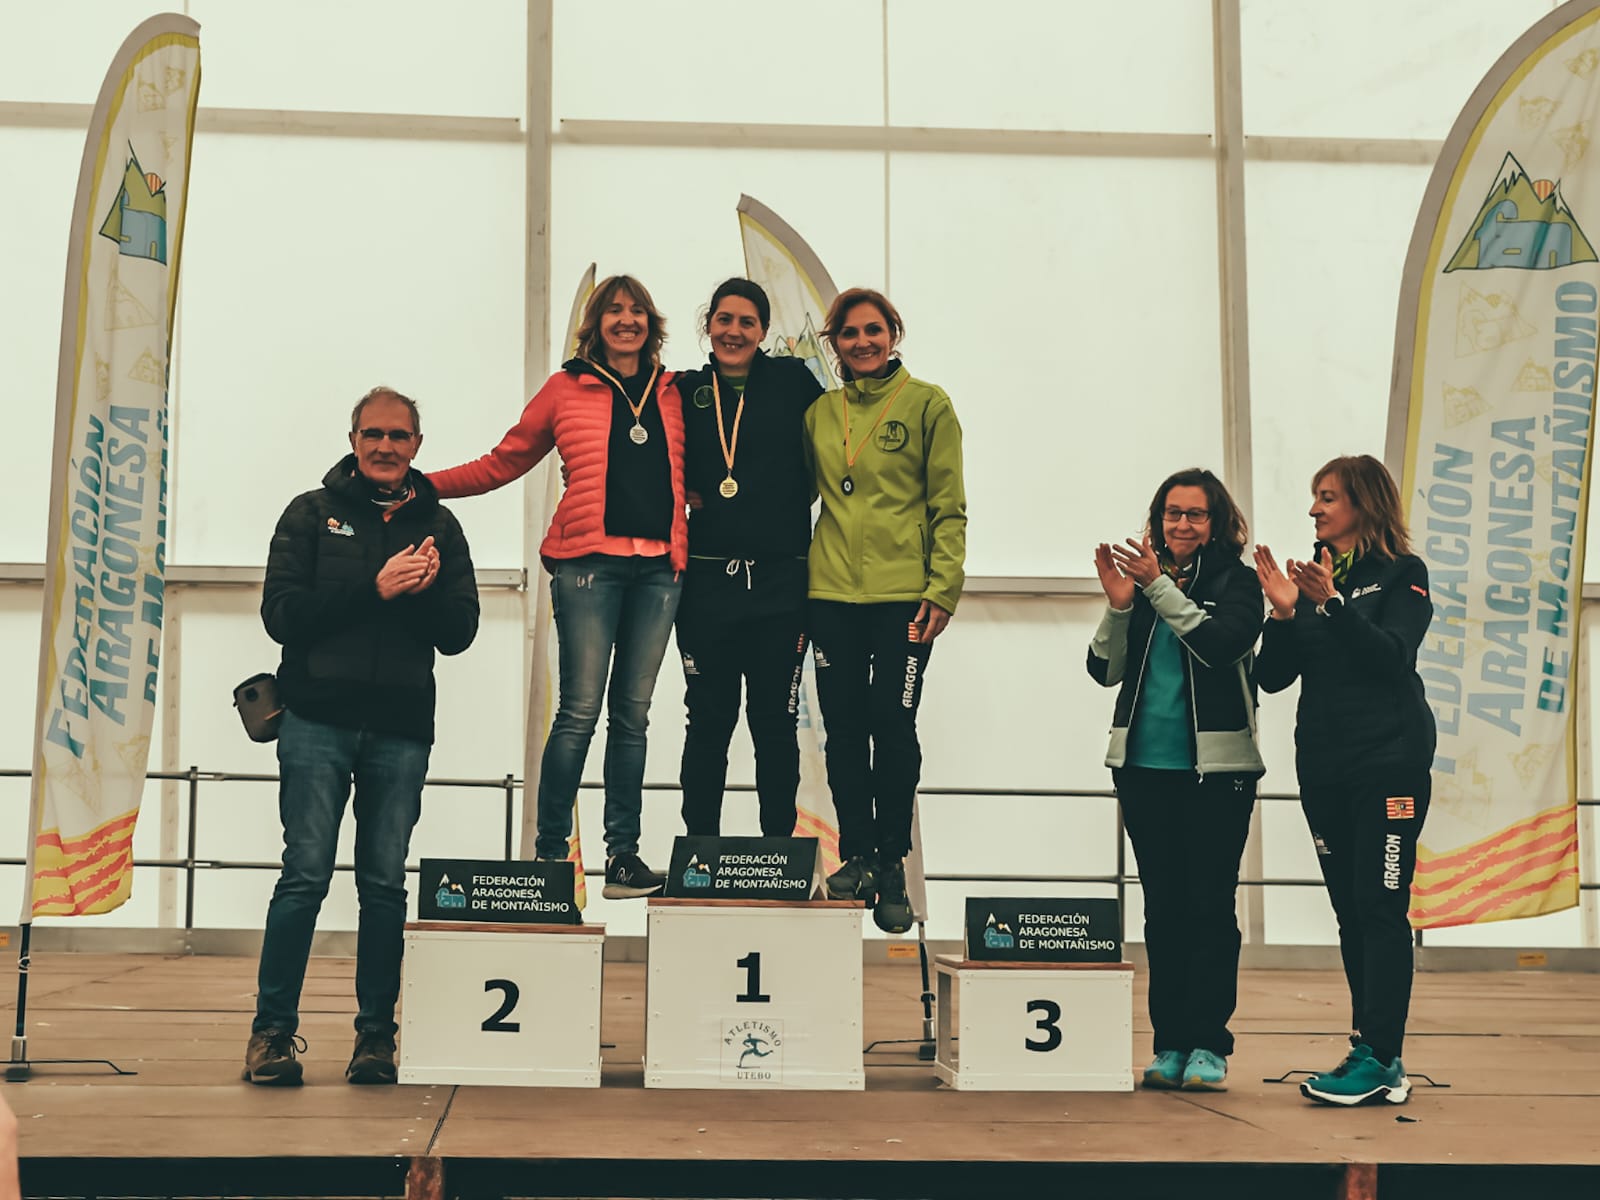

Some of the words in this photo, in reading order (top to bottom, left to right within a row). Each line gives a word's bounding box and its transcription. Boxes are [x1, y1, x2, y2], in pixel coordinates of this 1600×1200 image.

[1537, 280, 1599, 637] MONTAÑISMO
[90, 405, 150, 726] ARAGONESA
[1467, 417, 1536, 736] ARAGONESA
[46, 413, 105, 759] FEDERACIÓN
[901, 656, 918, 708] ARAGON
[1537, 646, 1569, 713] DE
[716, 867, 783, 877] ARAGONESA
[719, 853, 788, 865] FEDERACIÓN
[1383, 833, 1401, 890] ARAGON
[472, 875, 545, 887] FEDERACIÓN
[472, 888, 542, 899] ARAGONESA
[715, 879, 730, 889] DE
[733, 877, 807, 889] MONTAÑISMO
[472, 900, 488, 910] DE
[490, 899, 570, 913] MONTAÑISMO
[1018, 913, 1090, 925] FEDERACIÓN
[1018, 927, 1088, 937] ARAGONESA
[1019, 939, 1035, 949] DE
[1038, 938, 1115, 951] MONTAÑISMO
[736, 952, 770, 1002] 1
[481, 979, 520, 1032] 2
[724, 1021, 781, 1047] ATLETISMO
[1025, 1000, 1062, 1052] 3
[737, 1071, 771, 1080] UTEBO
